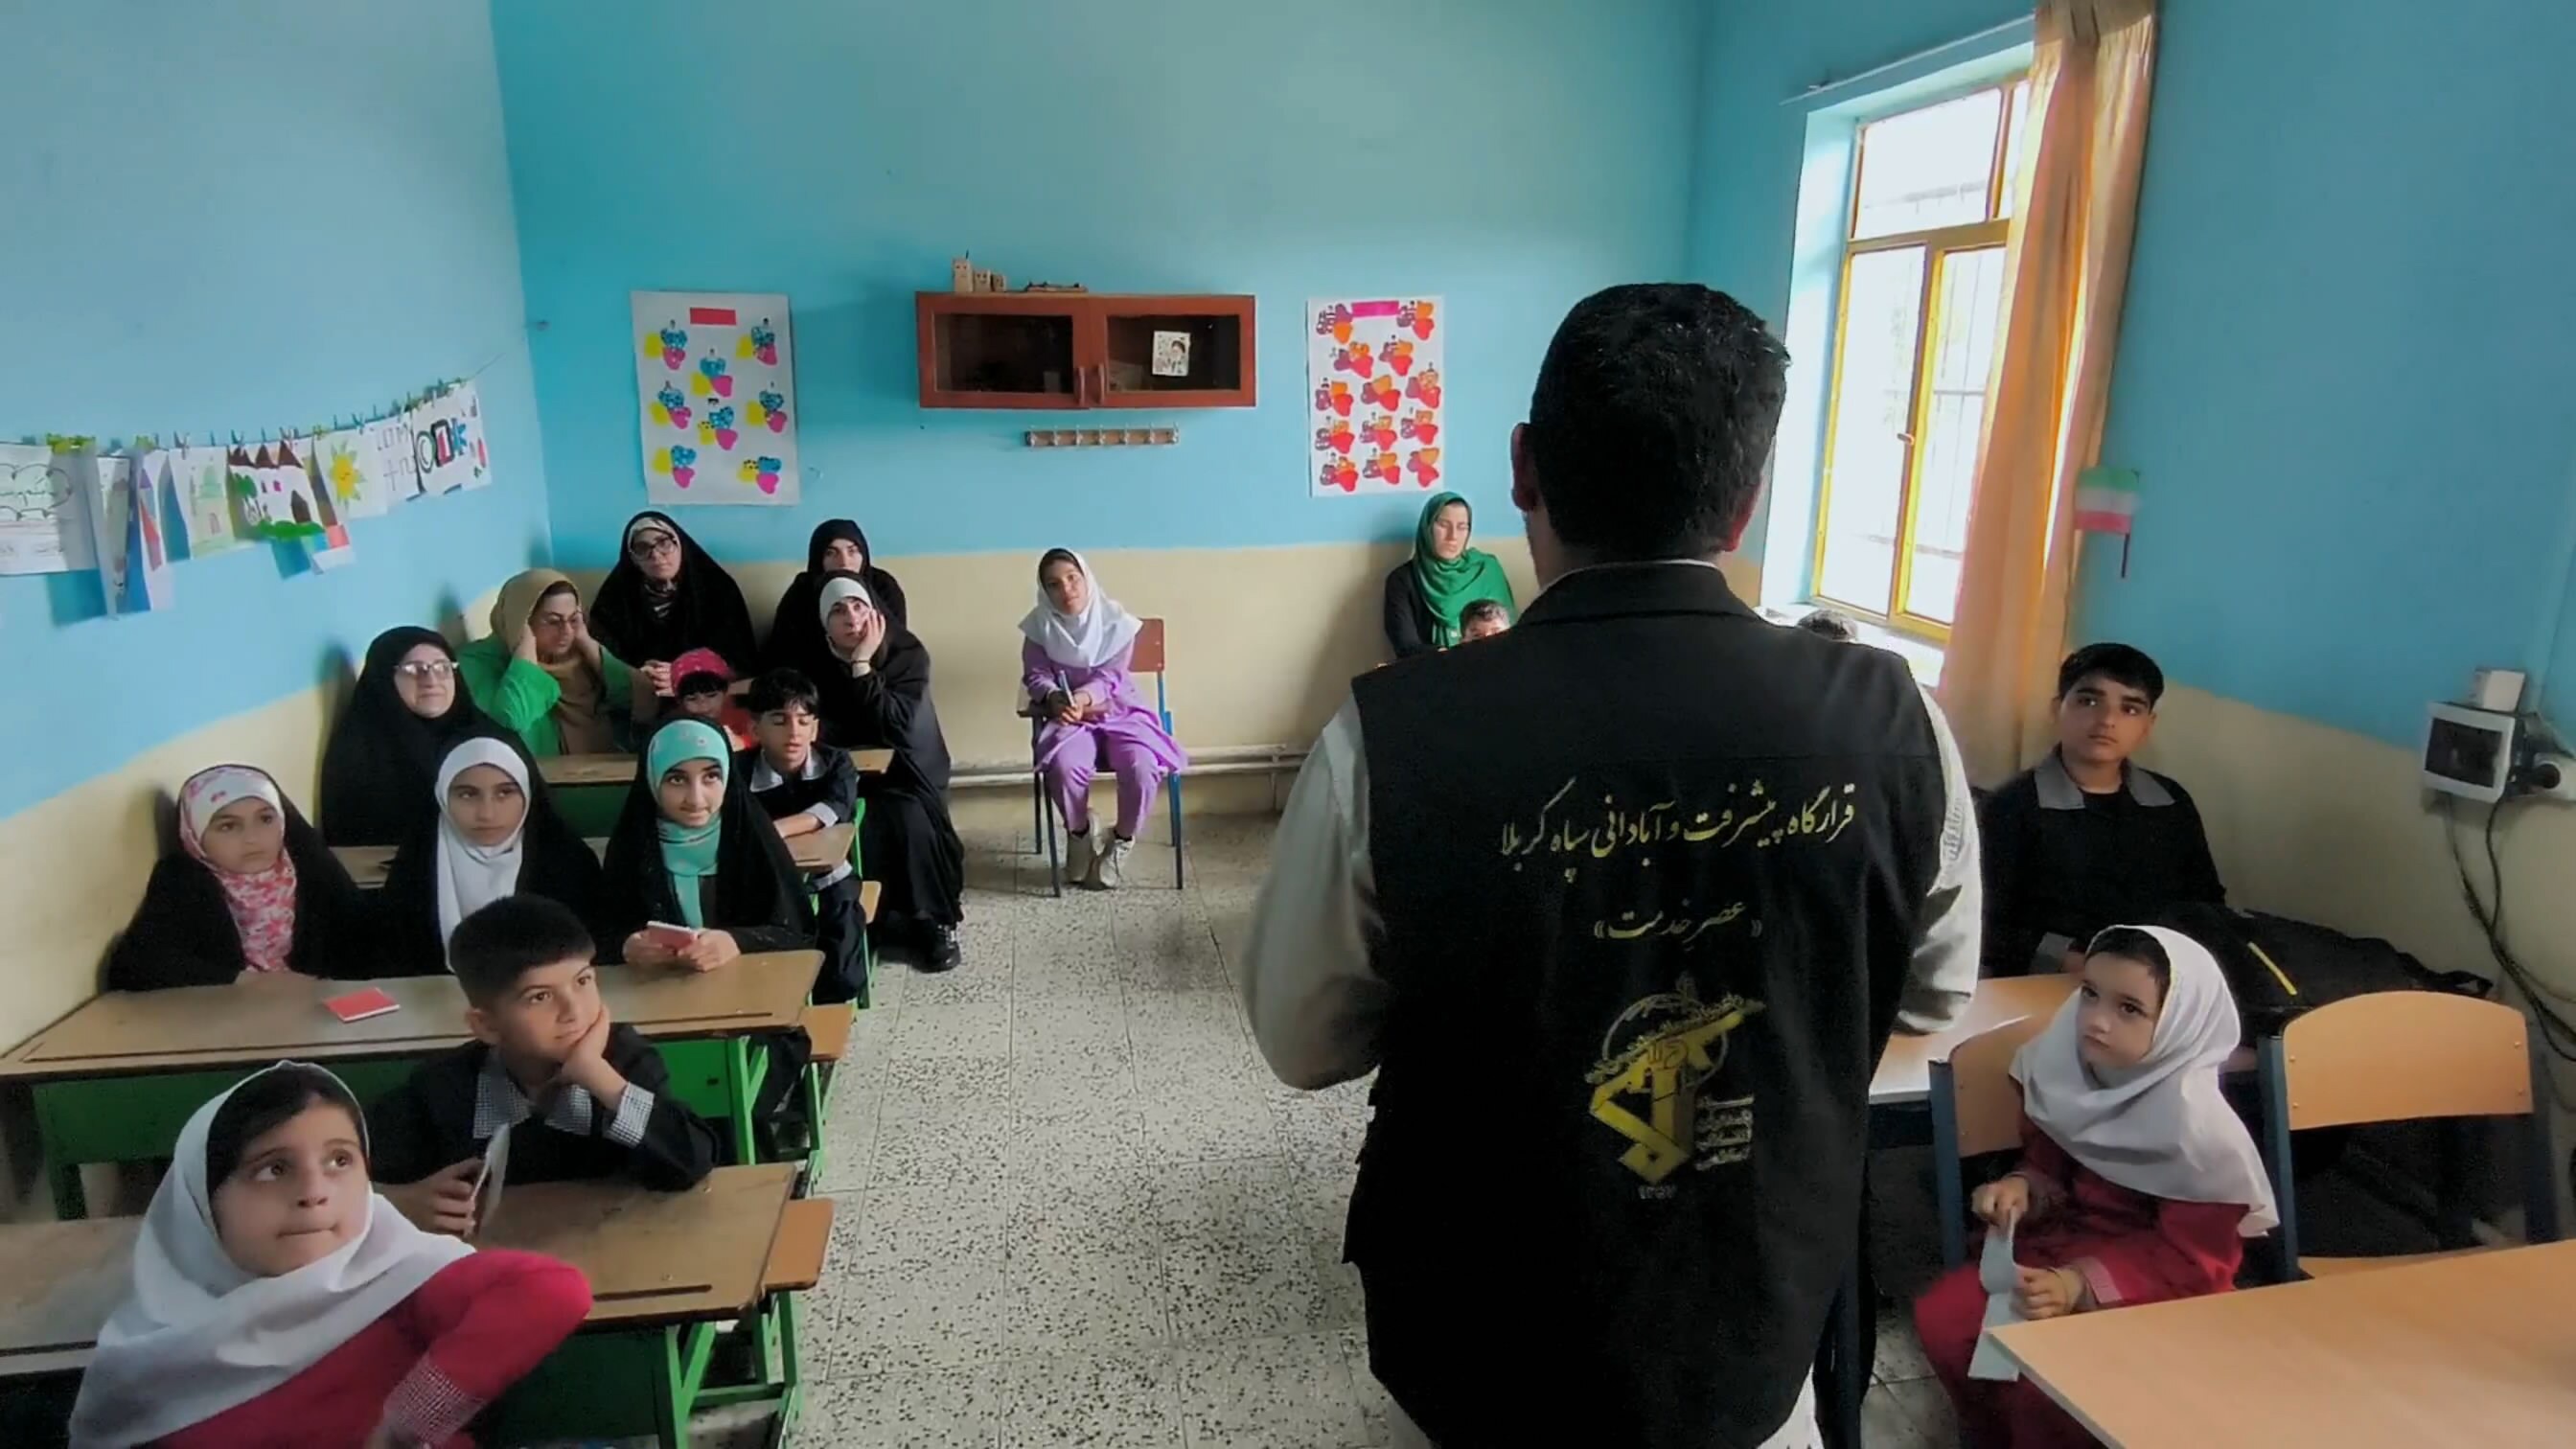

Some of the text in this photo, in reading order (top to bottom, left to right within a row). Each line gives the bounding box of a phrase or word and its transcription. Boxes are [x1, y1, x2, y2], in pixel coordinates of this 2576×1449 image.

[1500, 775, 1856, 884] قرارگاه پیشرفت و آبادانی سپاه کربلا
